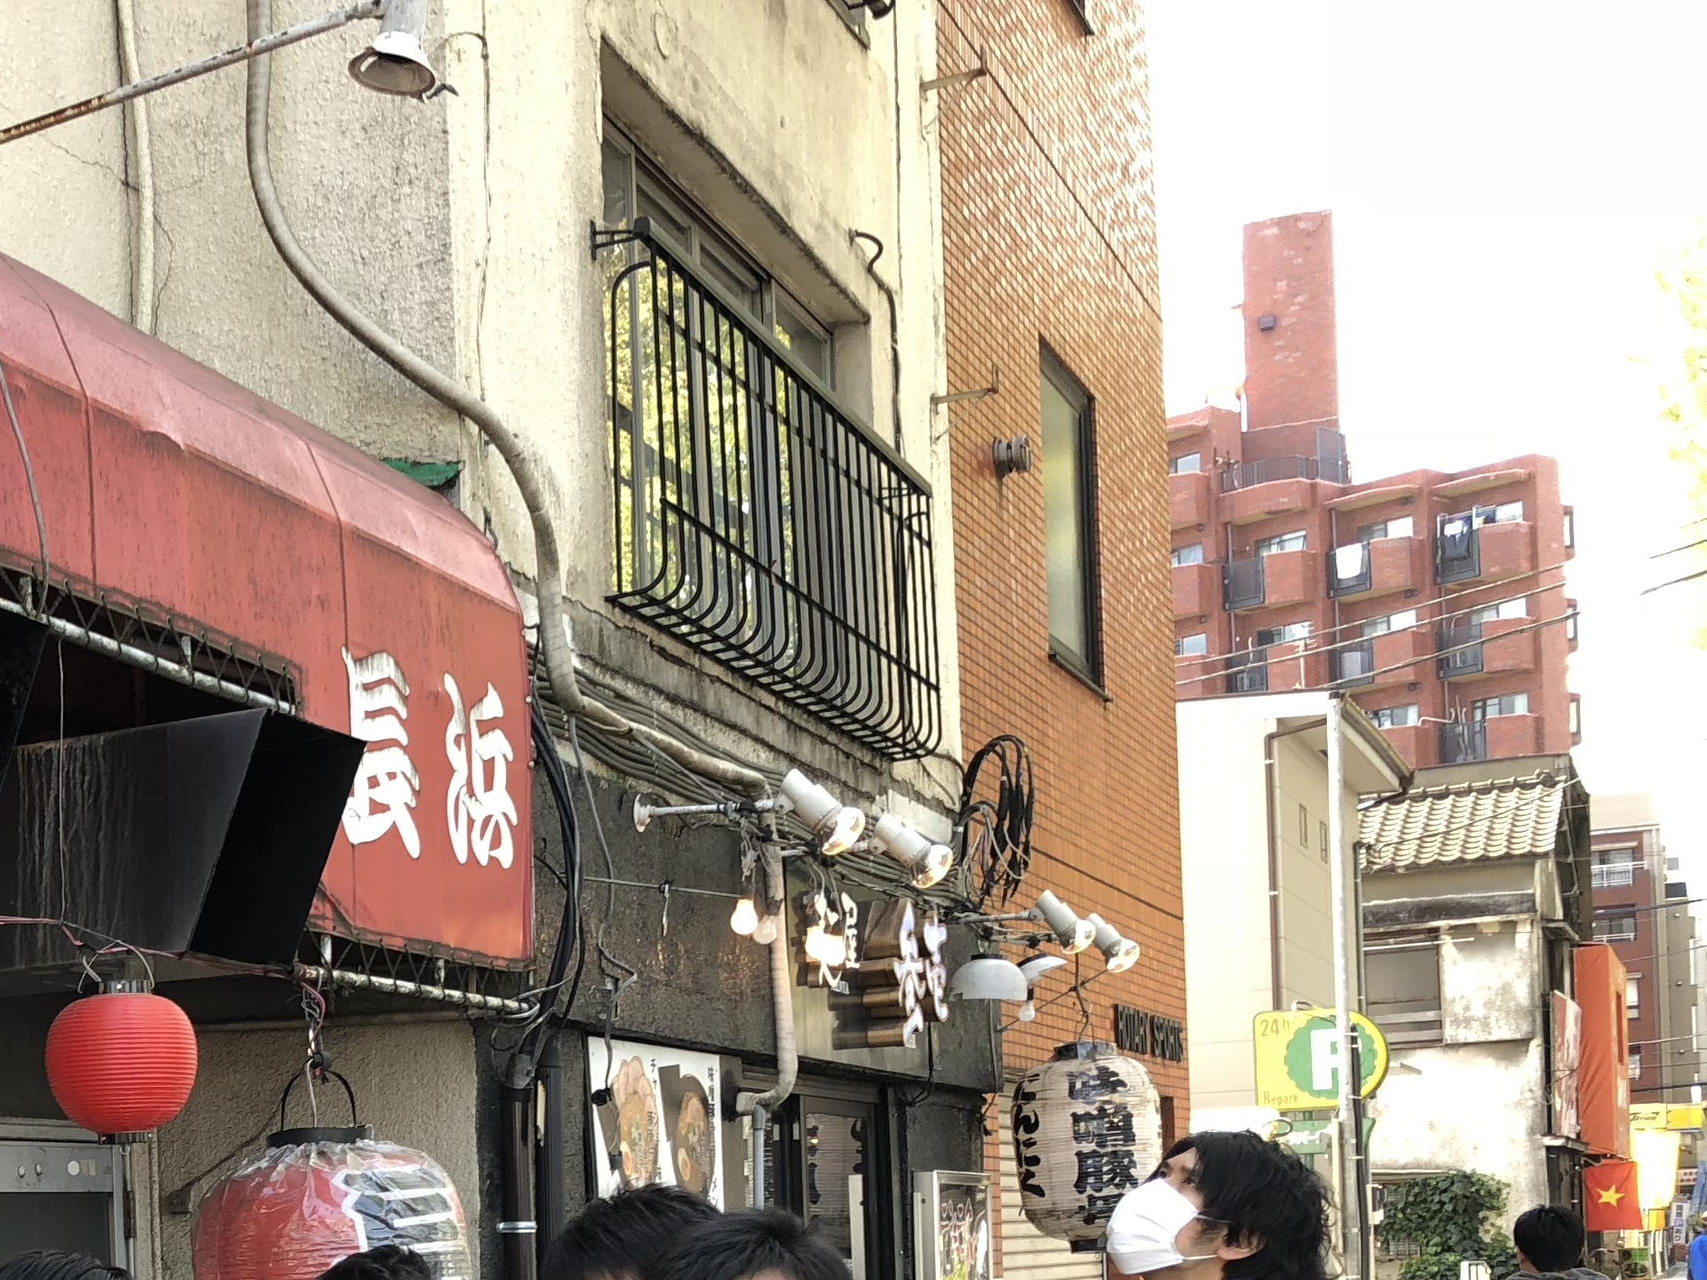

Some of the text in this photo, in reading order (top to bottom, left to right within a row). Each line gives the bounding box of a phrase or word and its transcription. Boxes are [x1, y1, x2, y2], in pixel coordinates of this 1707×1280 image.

[341, 645, 517, 870] 長浜
[1115, 1003, 1184, 1063] ROTARY SPORTS
